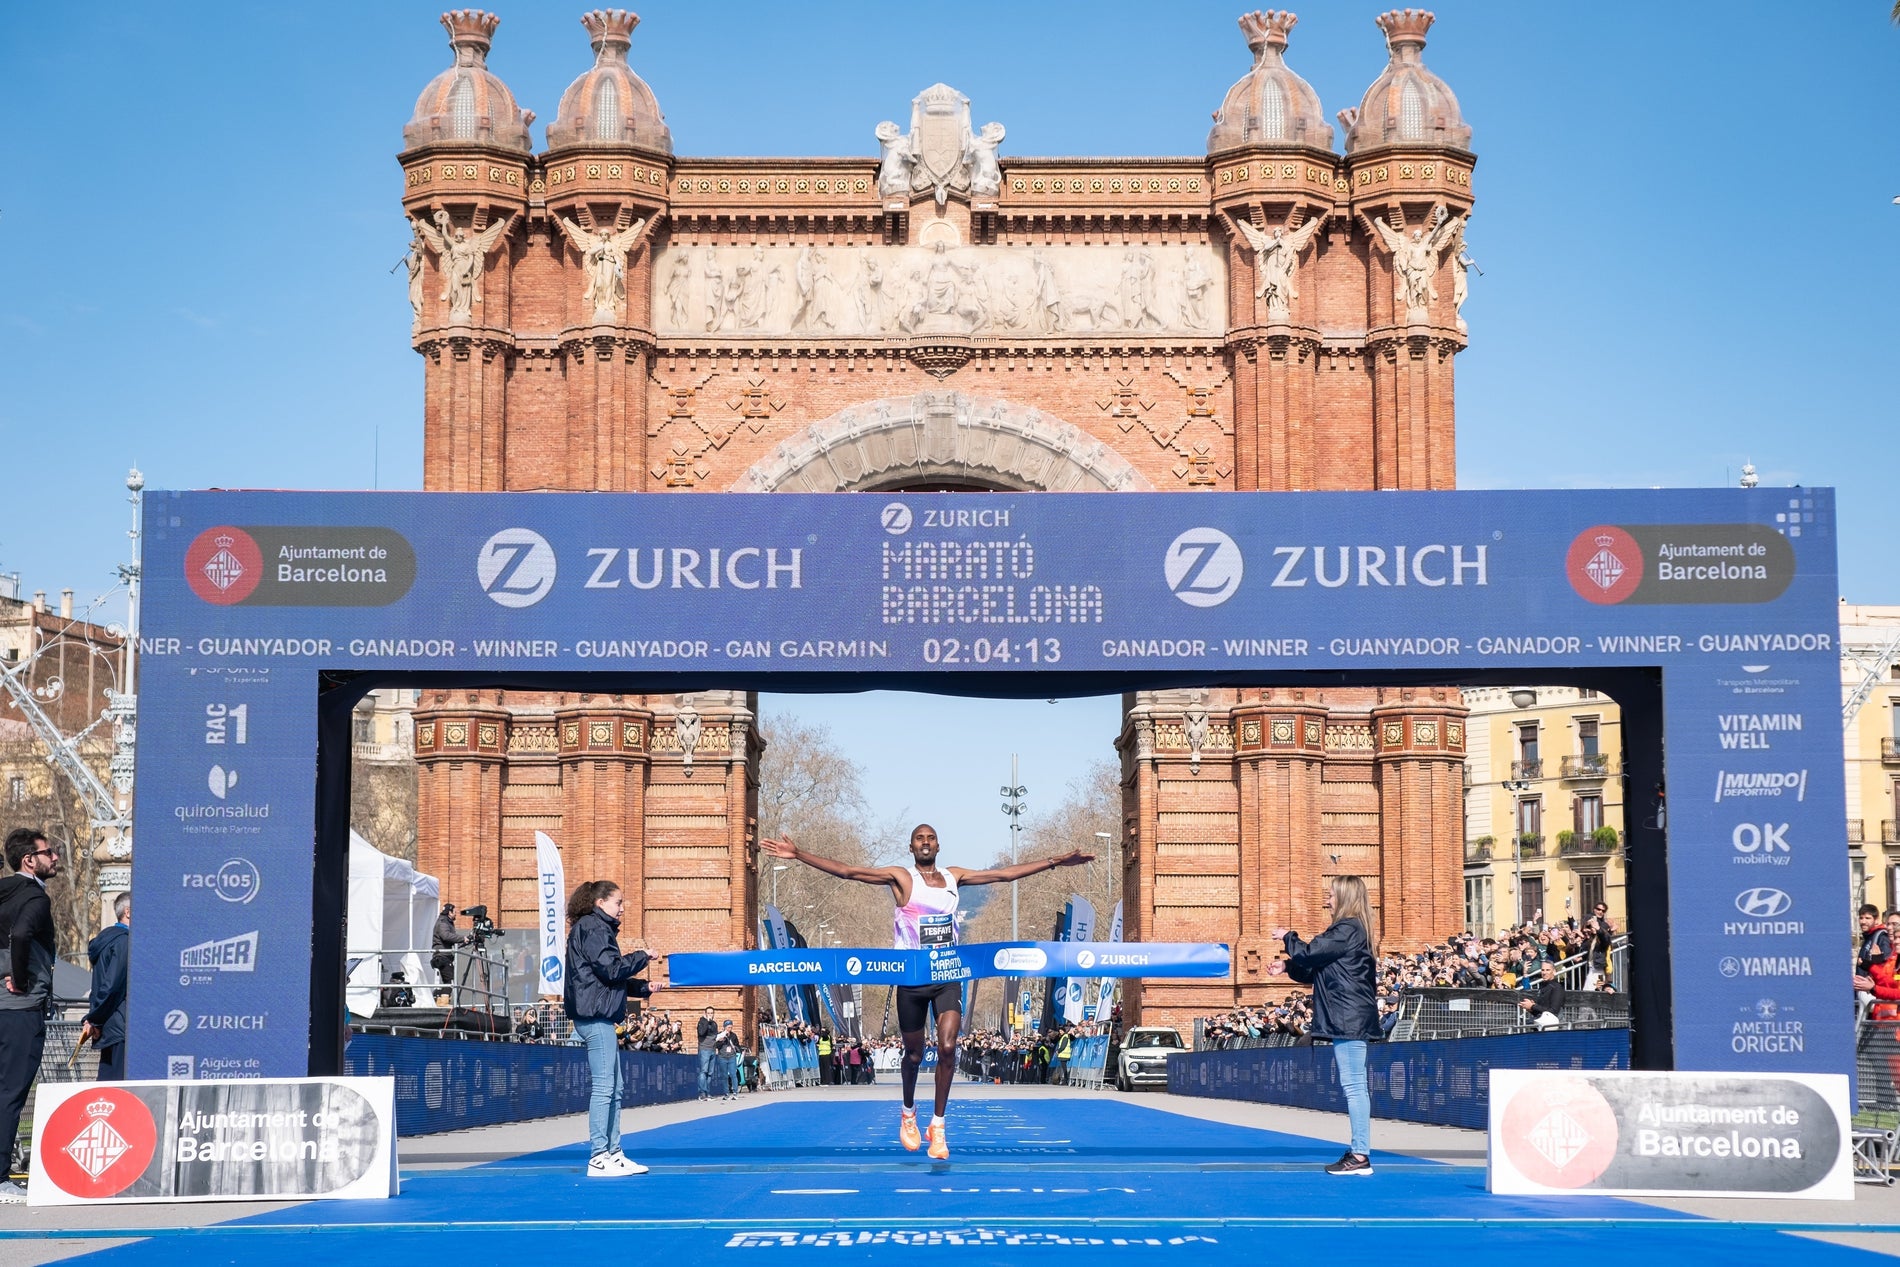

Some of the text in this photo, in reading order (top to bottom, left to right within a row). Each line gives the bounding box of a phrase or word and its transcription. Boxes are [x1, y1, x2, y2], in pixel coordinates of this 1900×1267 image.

[923, 509, 1009, 528] ZURICH
[278, 545, 387, 562] Ajuntament de
[883, 534, 1034, 580] MARATÓ
[1658, 542, 1767, 560] Ajuntament de
[277, 564, 388, 583] Barcelona
[583, 547, 803, 590] ZURICH
[1271, 545, 1488, 588] ZURICH
[1658, 561, 1767, 581] Barcelona
[883, 585, 1102, 624] BARCELONA
[198, 637, 332, 656] GUANYADOR
[349, 638, 455, 657] GANADOR
[472, 639, 558, 658] WINNER
[575, 640, 709, 658] GUANYADOR
[727, 640, 771, 658] GAN
[779, 640, 887, 658] GARMIN
[923, 638, 1061, 664] 02:04:13
[1102, 639, 1206, 658] GANADOR
[1223, 638, 1309, 657] WINNER
[1329, 637, 1460, 656] GUANYADOR
[1477, 636, 1581, 655] GANADOR
[1597, 635, 1681, 653] WINNER
[1698, 633, 1831, 653] GUANYADOR
[205, 703, 248, 744] RAC 1
[1718, 714, 1802, 732] VITAMIN
[1719, 732, 1770, 750] WELL
[1725, 773, 1799, 788] MUNDO
[1724, 787, 1782, 797] DEPORTIVO
[182, 824, 262, 835] Healthcare Partner
[1732, 822, 1791, 853] OK
[1733, 854, 1778, 866] mobility
[924, 926, 952, 936] TESFAYE
[1724, 921, 1804, 935] HYUNDAI
[182, 940, 250, 966] FINISHER
[1100, 954, 1149, 965] ZURICH
[749, 962, 823, 974] BARCELONA
[866, 961, 905, 973] ZURICH
[1741, 956, 1812, 976] YAMAHA
[197, 1015, 264, 1030] ZURICH
[1732, 1021, 1804, 1034] AMETLLER
[1731, 1035, 1804, 1053] ORIGEN
[200, 1057, 260, 1070] Aigües de
[200, 1071, 261, 1080] Barcelona
[179, 1109, 340, 1134] Ajuntament de
[1638, 1104, 1800, 1126] Ajuntament de
[177, 1136, 340, 1163] Barcelona
[1638, 1129, 1802, 1159] Barcelona
